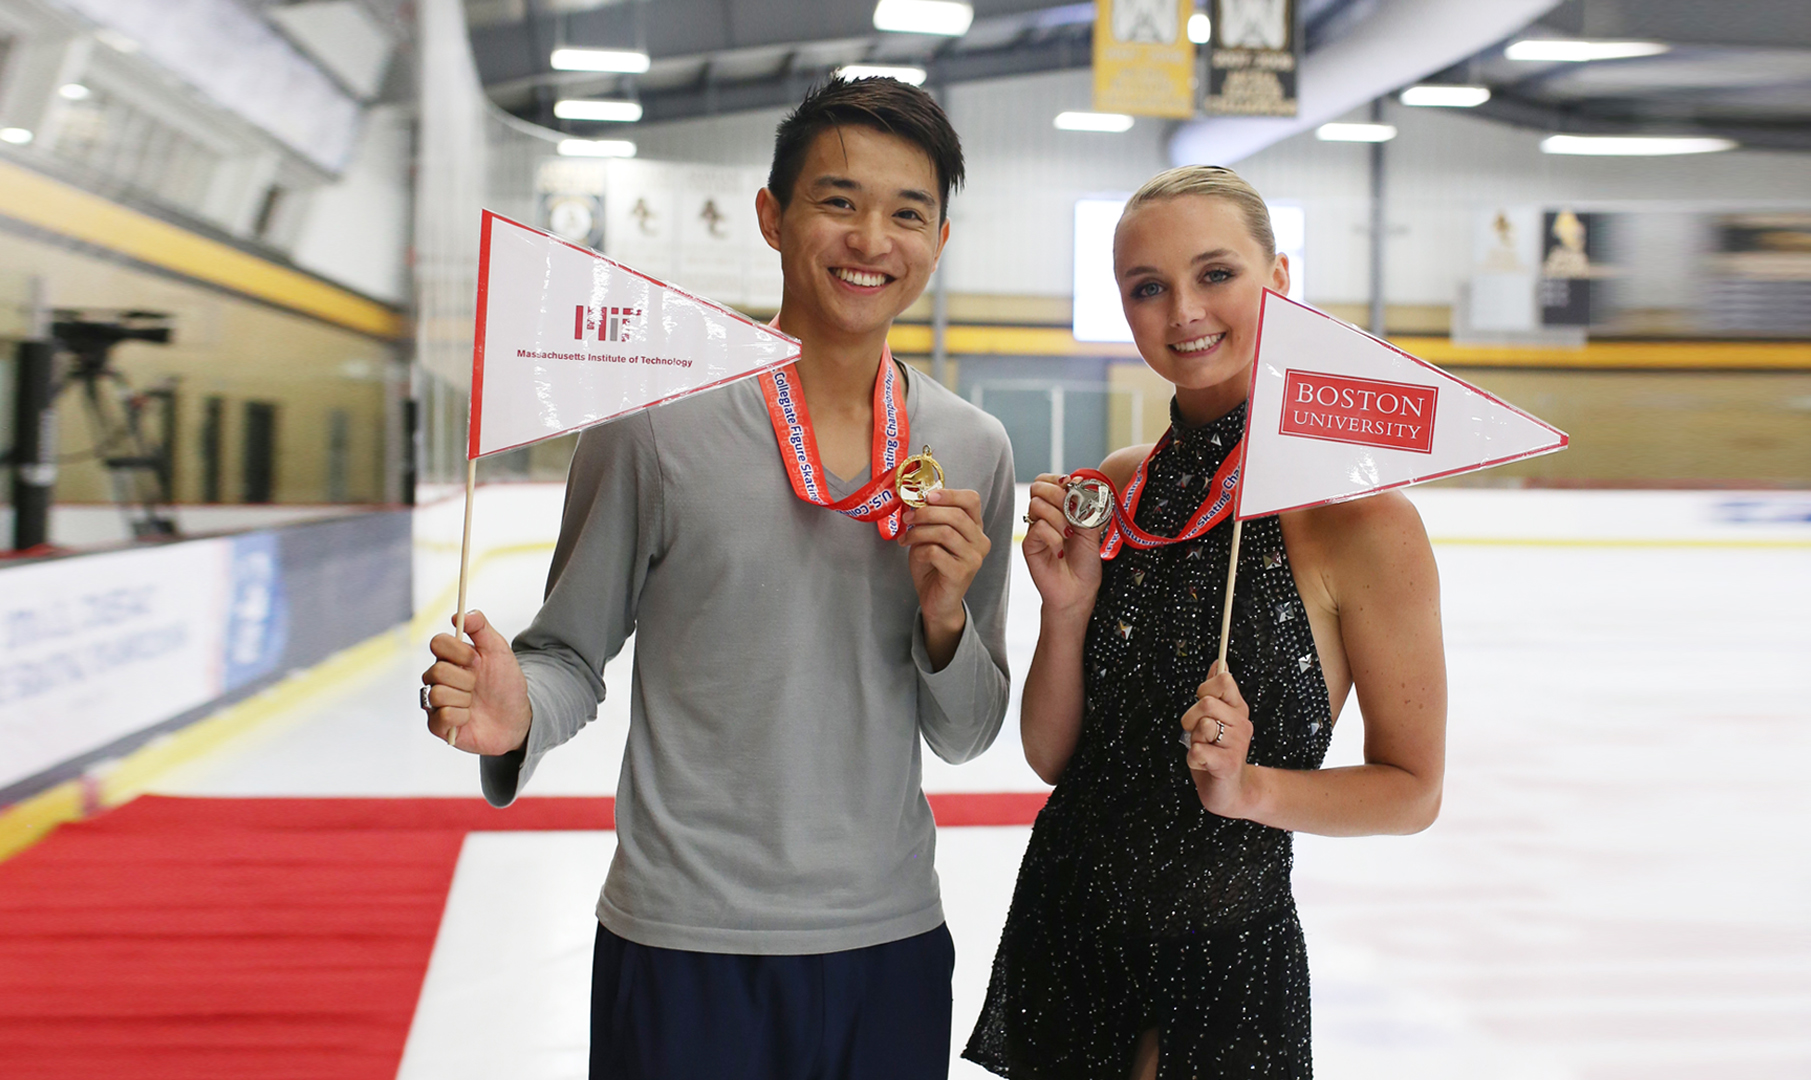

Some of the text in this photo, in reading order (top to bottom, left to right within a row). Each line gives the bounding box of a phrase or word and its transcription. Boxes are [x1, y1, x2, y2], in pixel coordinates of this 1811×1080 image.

[517, 350, 693, 368] Massachusetts Institute of Technology
[1296, 382, 1425, 418] BOSTON
[775, 372, 796, 424] Collegiate
[790, 426, 806, 462] Figure
[1294, 410, 1422, 440] UNIVERSITY
[885, 440, 898, 471] ating
[869, 489, 892, 508] U.S.
[1197, 490, 1231, 528] Skating
